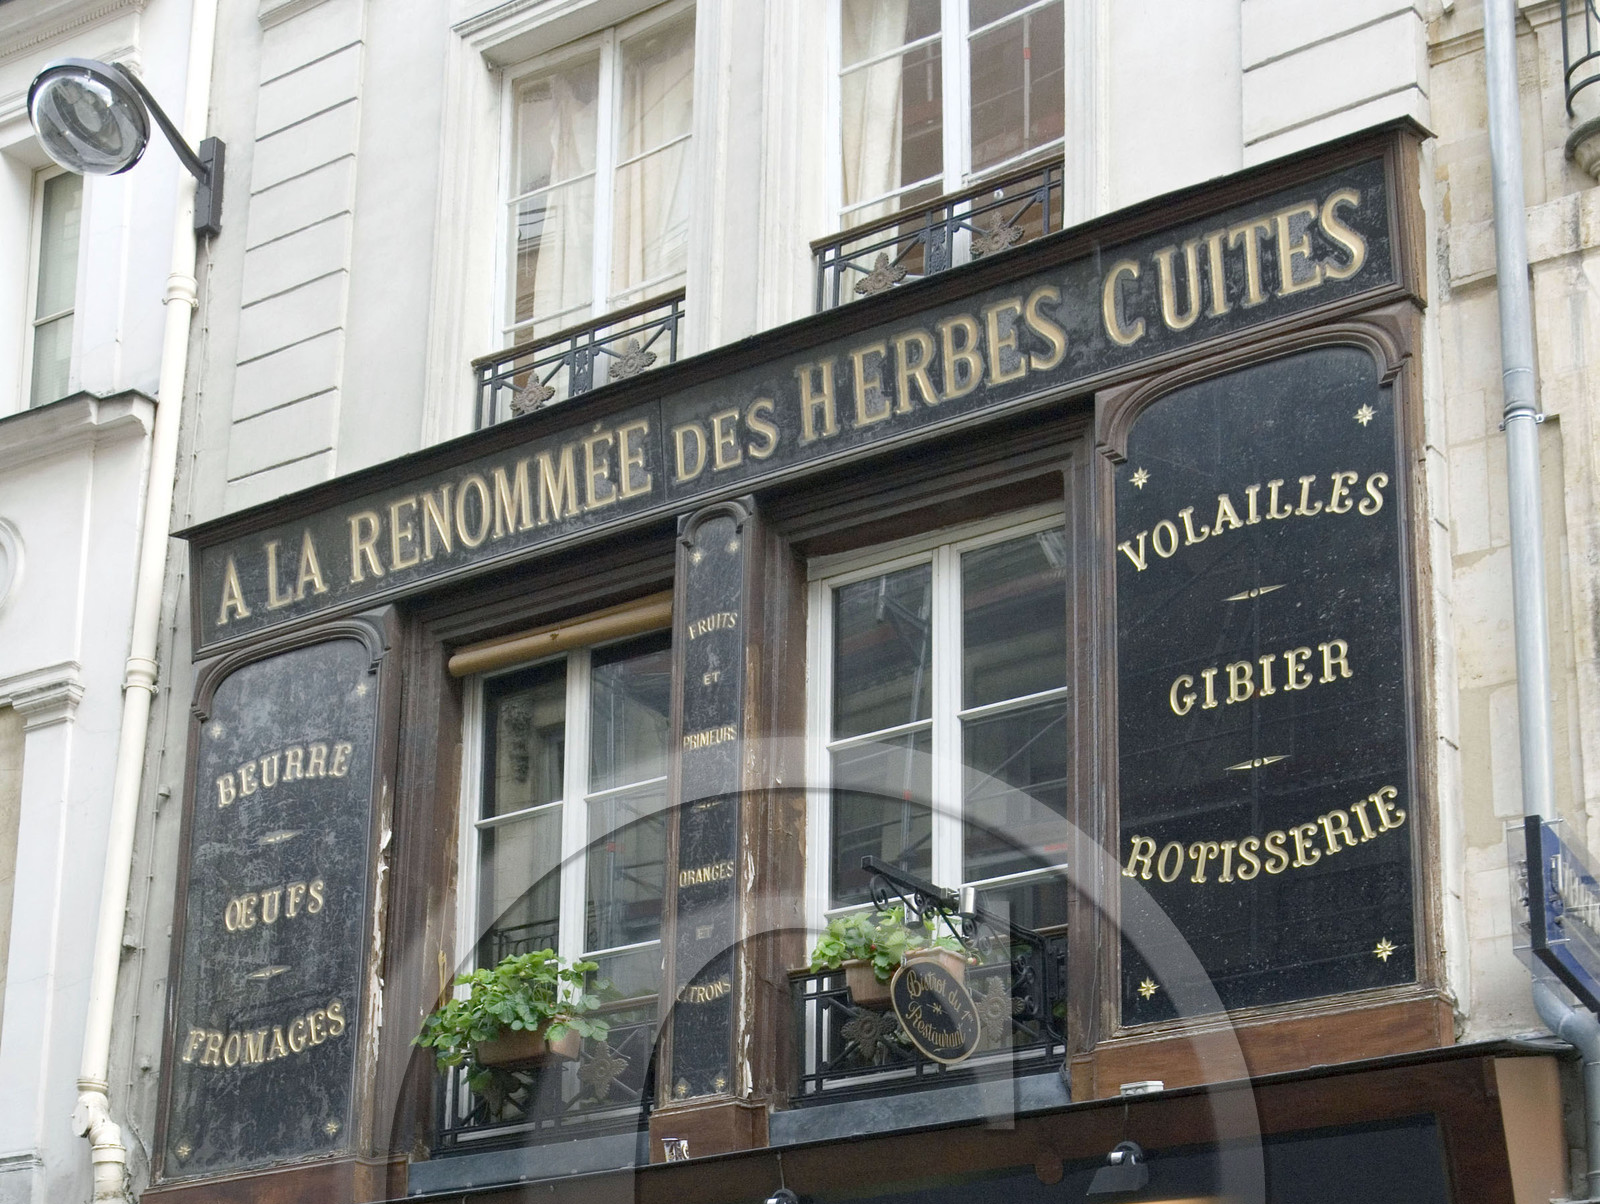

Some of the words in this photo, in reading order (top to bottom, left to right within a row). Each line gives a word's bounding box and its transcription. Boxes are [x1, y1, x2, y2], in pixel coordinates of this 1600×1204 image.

[216, 558, 252, 627] A
[264, 528, 330, 612] LA
[347, 419, 654, 586] RENOMMÉE
[672, 395, 779, 484] DES
[798, 285, 1068, 444] HERBES
[1100, 187, 1370, 348] CUITES
[1117, 471, 1390, 572] VOLAILLES
[688, 611, 738, 641] FRUITS
[703, 670, 722, 686] ET
[1168, 638, 1354, 717] GIBIER
[683, 724, 738, 752] PRIMEURS
[215, 740, 354, 809] BEURRE
[1121, 785, 1407, 884] ROTISSERIE
[678, 861, 735, 888] ORANGES
[676, 979, 732, 1004] CITRONS
[906, 969, 947, 1000] Bistrot
[948, 988, 963, 1013] du
[180, 1000, 347, 1069] FROMAGES
[905, 1001, 967, 1049] Restaurant
